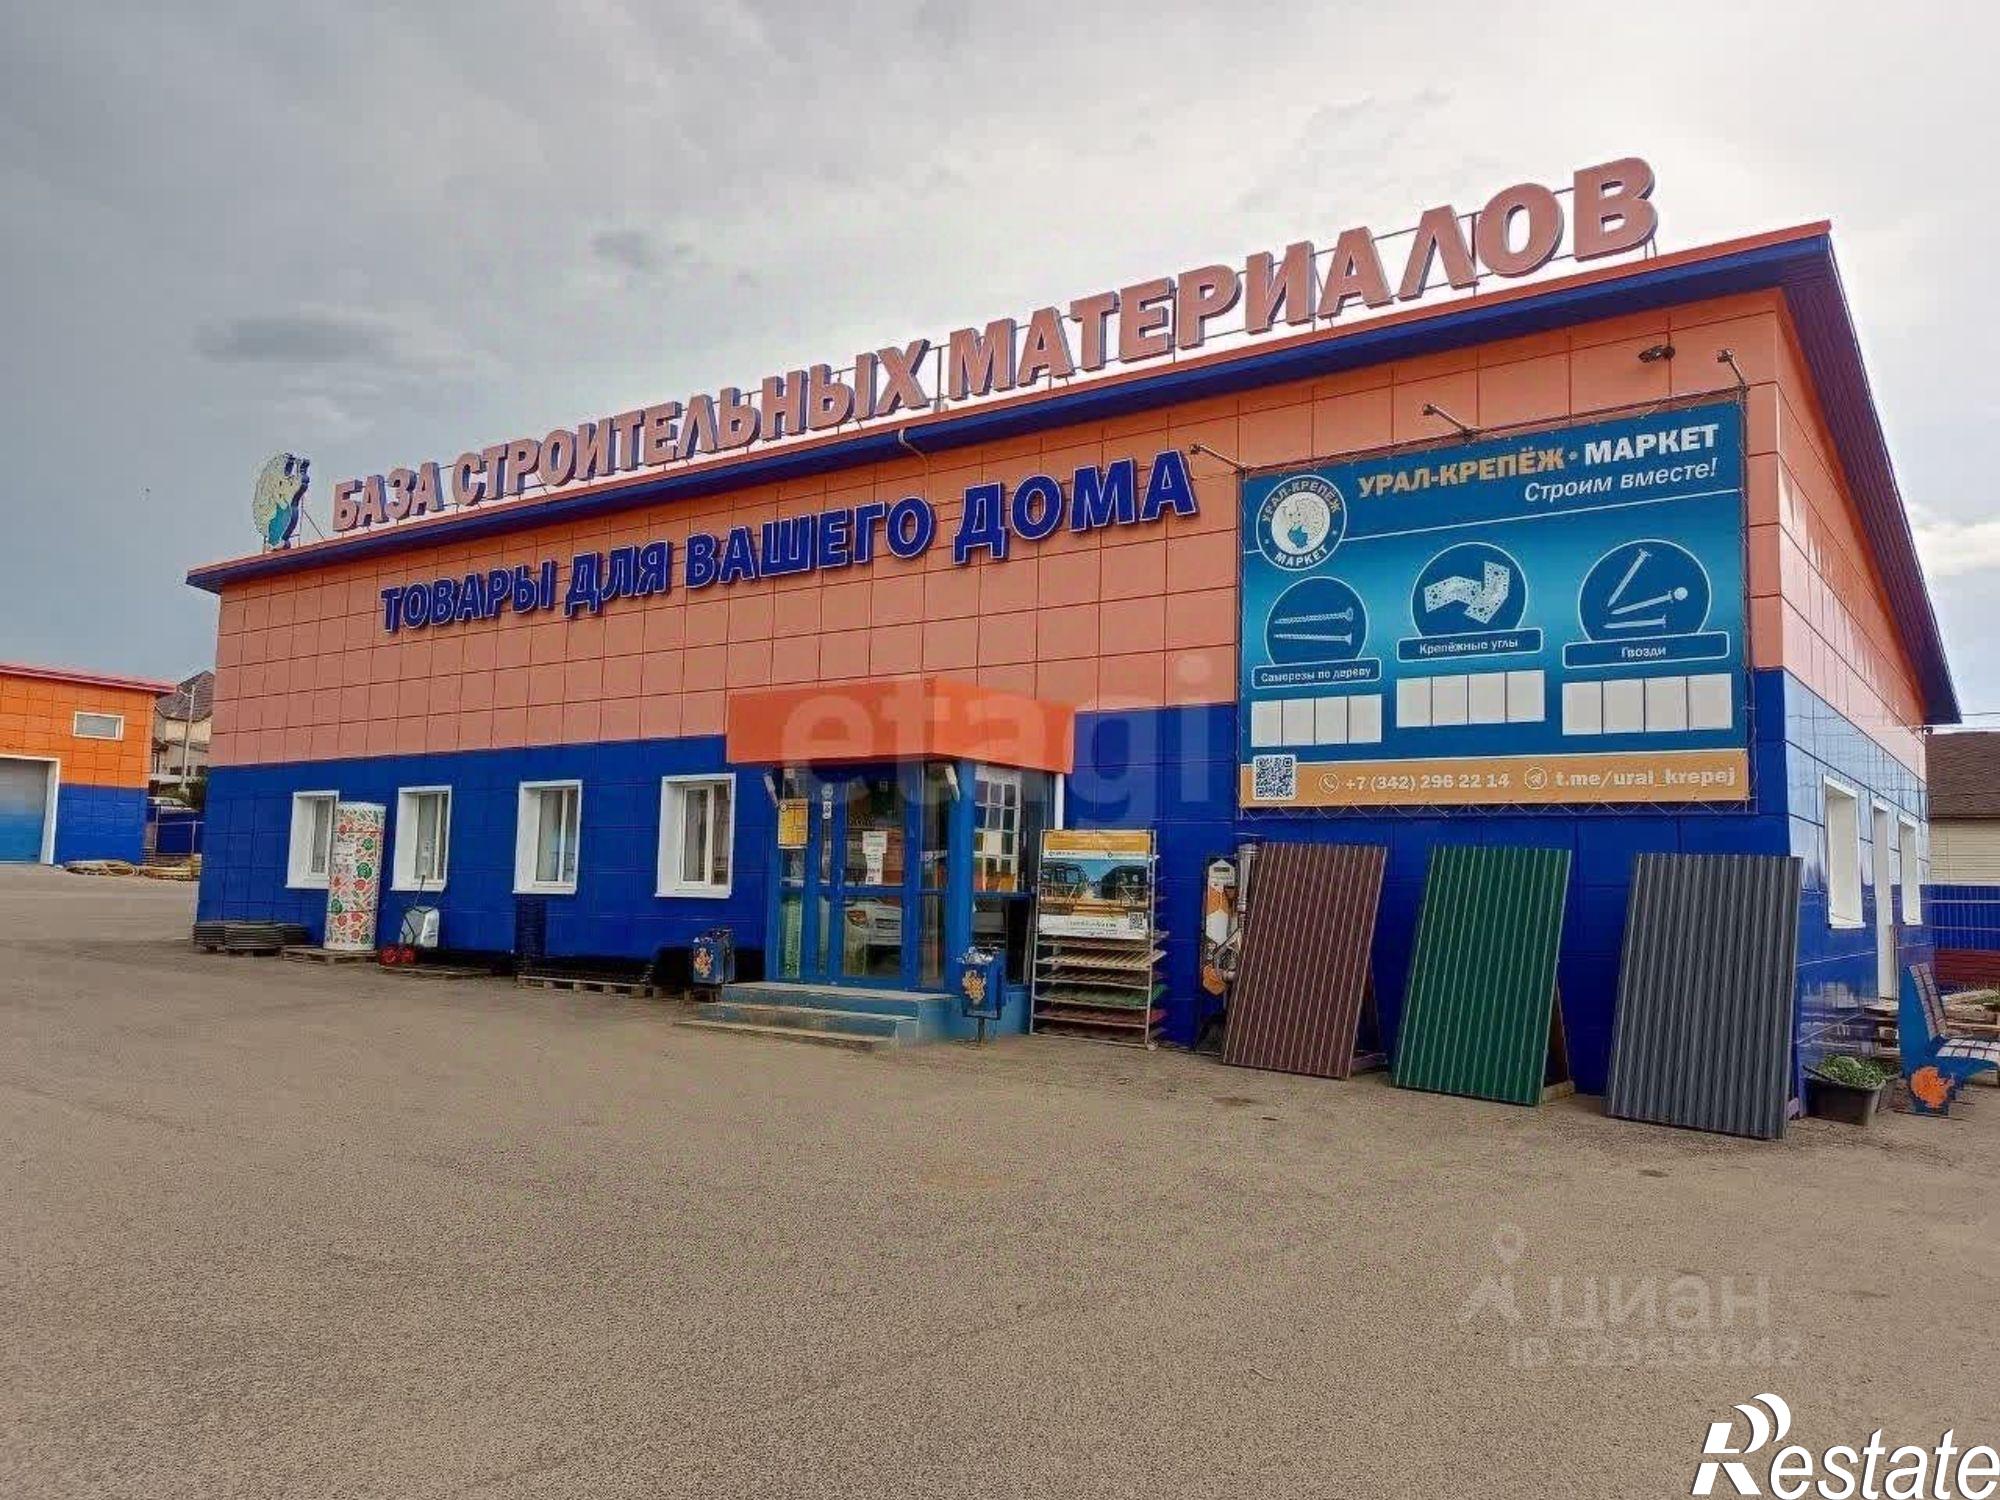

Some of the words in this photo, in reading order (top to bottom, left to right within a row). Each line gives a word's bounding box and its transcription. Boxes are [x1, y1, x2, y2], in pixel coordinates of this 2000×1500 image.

[333, 462, 443, 532] БАЗА
[452, 339, 932, 506] СТРОИТЕЛЬНЫХ
[947, 157, 1659, 401] МАТЕРИАЛОВ
[1358, 446, 1565, 498] УРАЛ-КРЕПЁЖ
[1584, 423, 1720, 466] МАРКЕТ
[1524, 474, 1612, 503] Строим
[1619, 457, 1718, 490] вместе!
[380, 560, 557, 633] ТОВАРЫ
[564, 540, 673, 618] ДЛЯ
[684, 497, 937, 591] ВАШЕГО
[953, 449, 1198, 565] ДОМА
[1274, 545, 1328, 567] МАРКЕТ
[1490, 636, 1519, 653] углы
[1620, 643, 1667, 660] Гвозди
[1260, 669, 1316, 684] Саморезы
[1318, 670, 1331, 681] по
[1332, 665, 1372, 681] дереву
[1346, 775, 1365, 790] +7
[1370, 774, 1416, 792] (342)
[1458, 773, 1483, 789] 22
[1485, 772, 1511, 788] 14
[1555, 765, 1737, 789] t.me/ural_krepej
